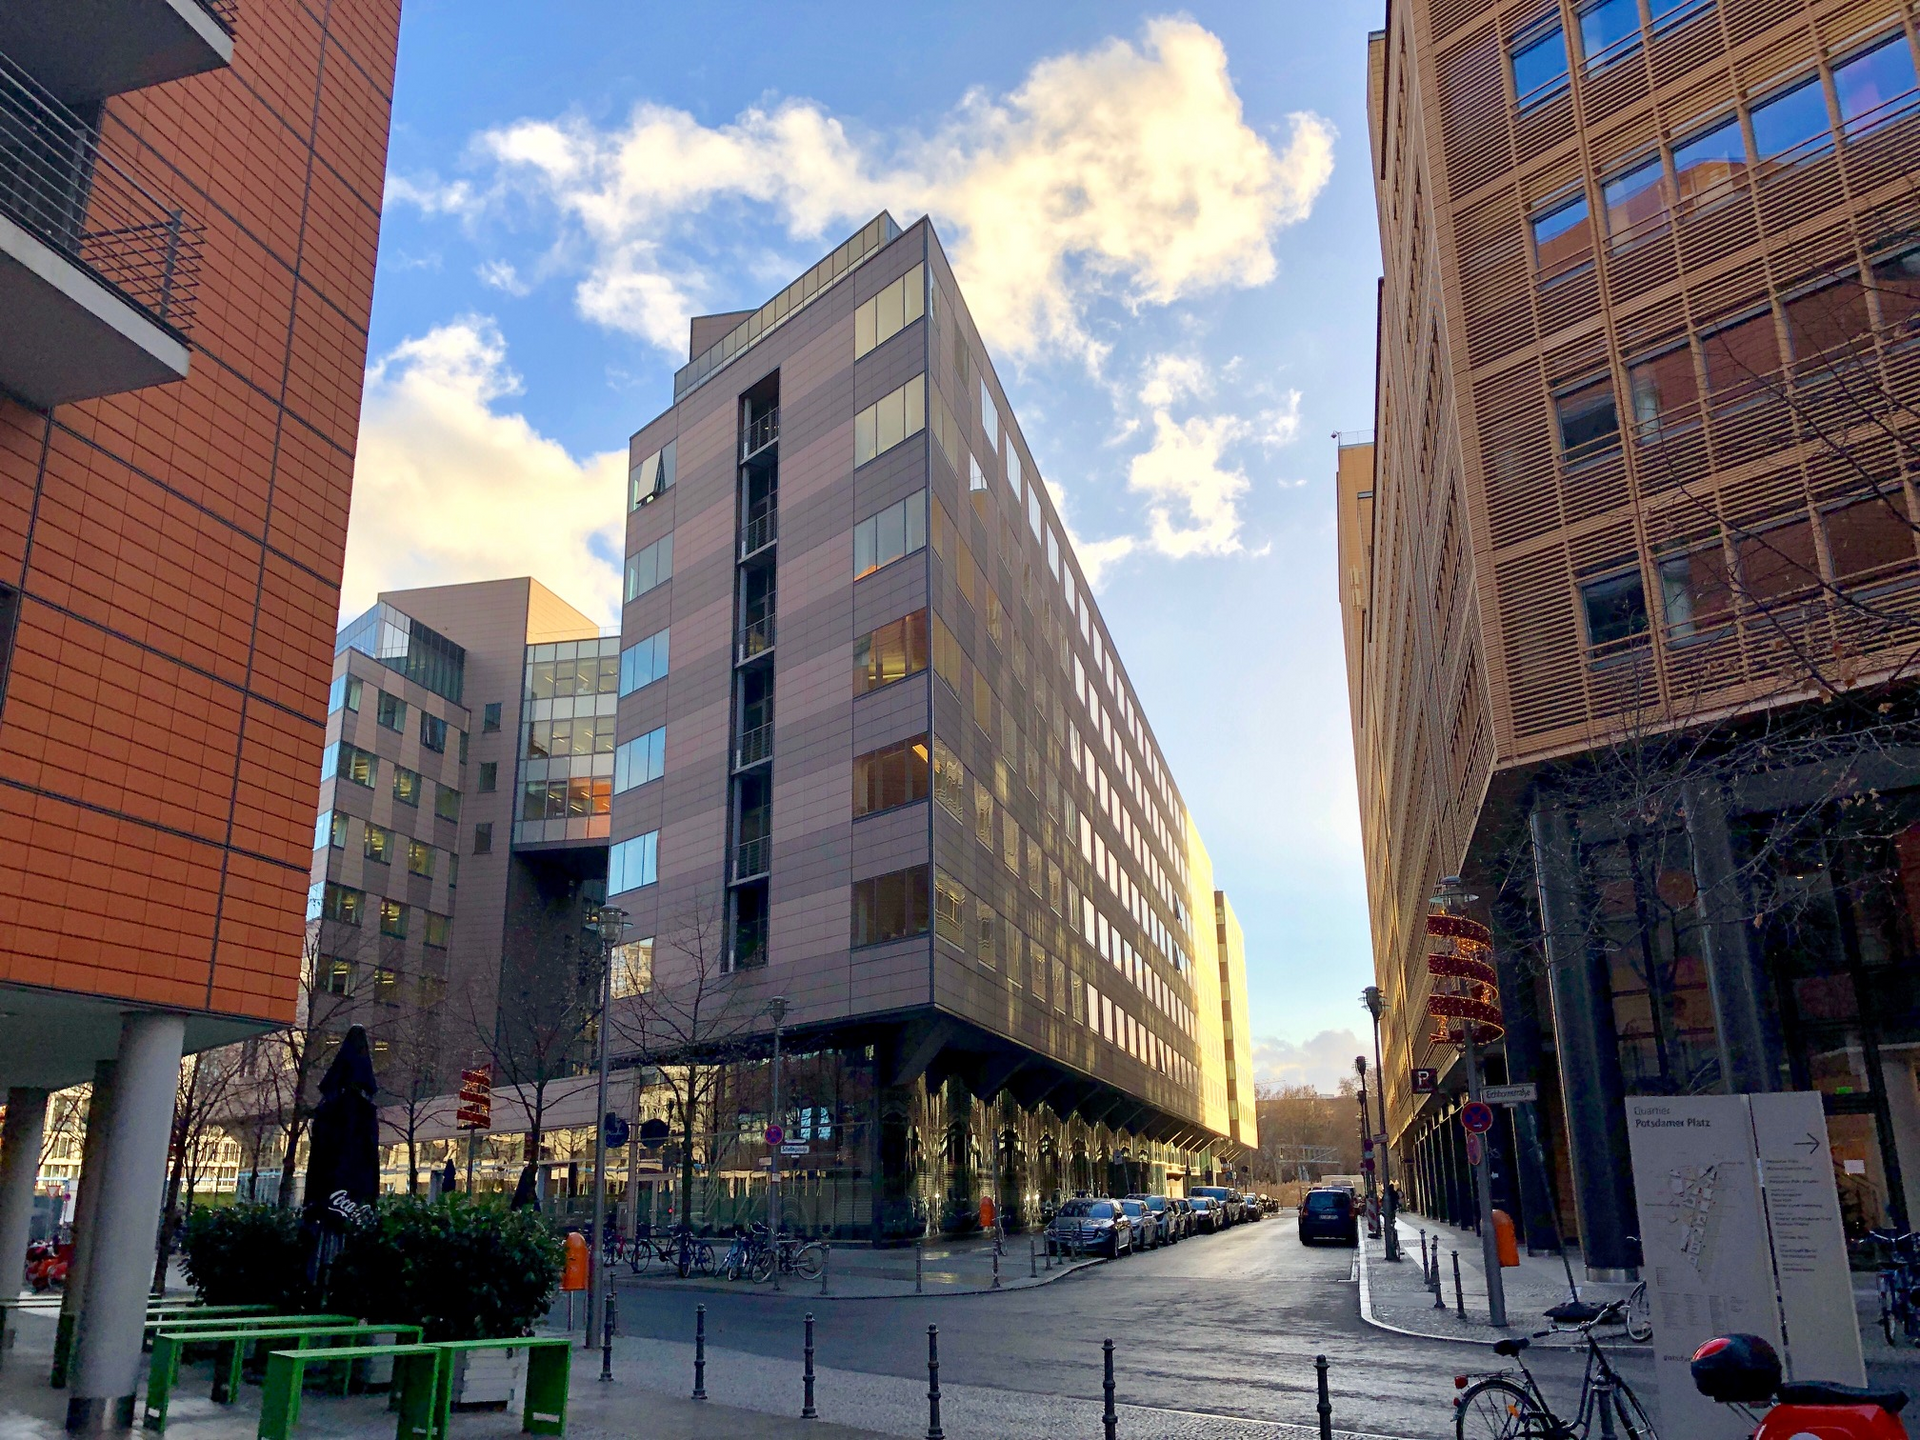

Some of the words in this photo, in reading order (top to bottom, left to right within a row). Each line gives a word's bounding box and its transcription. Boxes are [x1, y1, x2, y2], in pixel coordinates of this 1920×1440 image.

[1634, 1106, 1670, 1115] Quartier
[1635, 1118, 1685, 1128] Potsdamer
[1687, 1117, 1711, 1127] Platz
